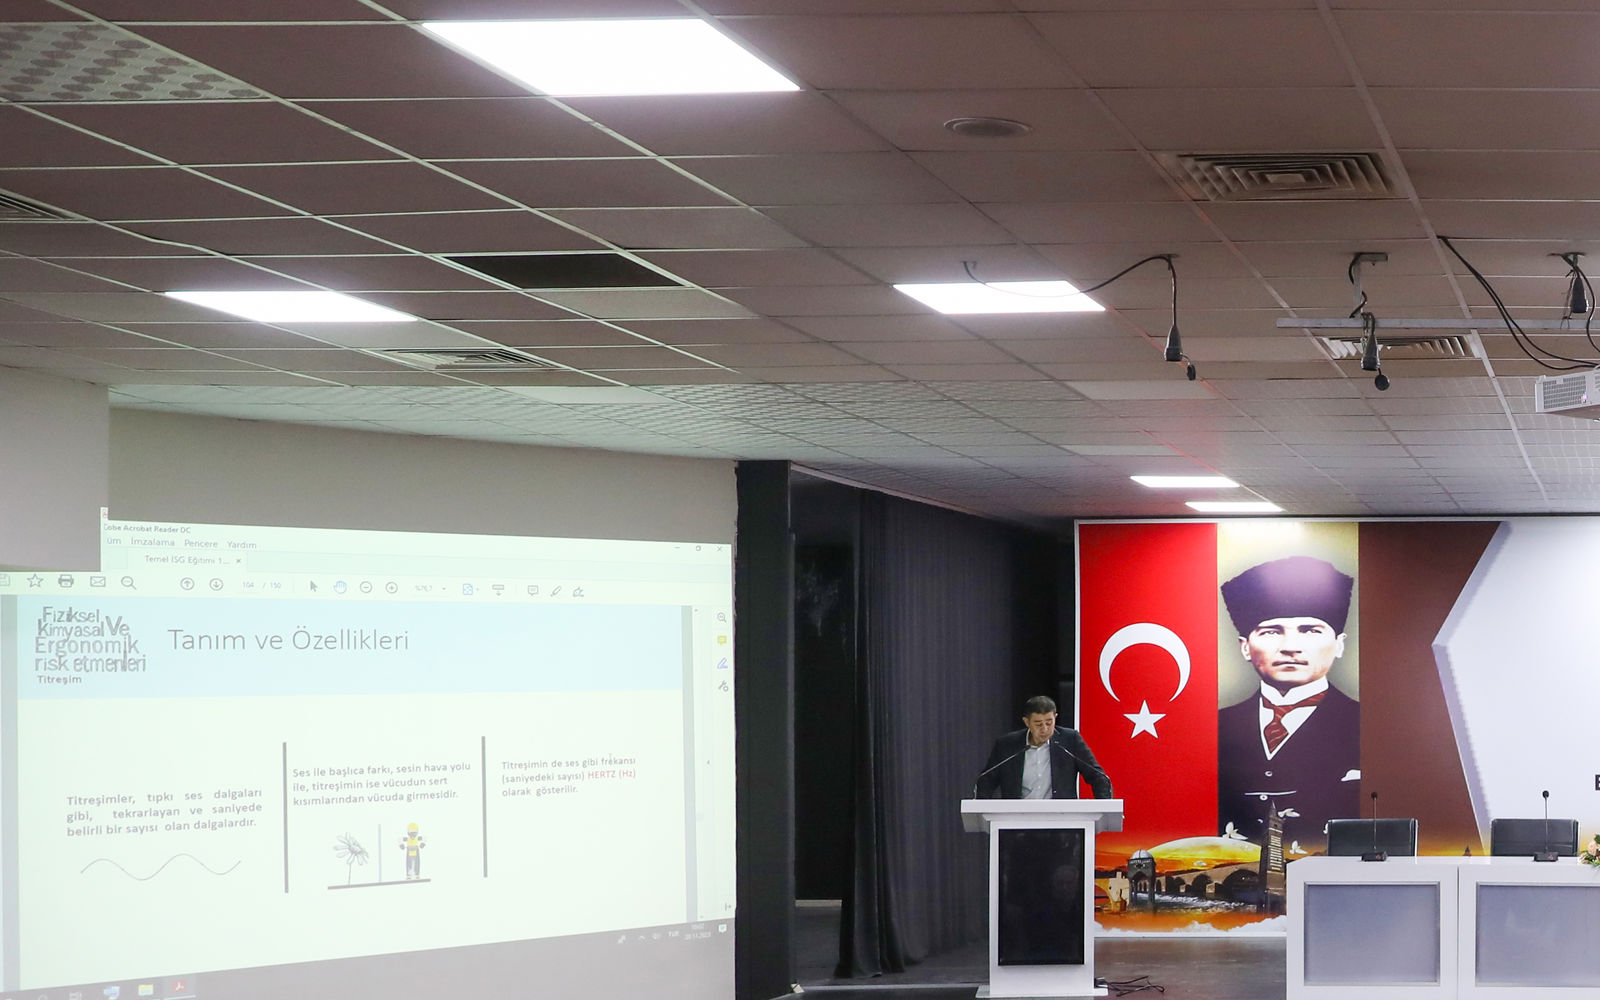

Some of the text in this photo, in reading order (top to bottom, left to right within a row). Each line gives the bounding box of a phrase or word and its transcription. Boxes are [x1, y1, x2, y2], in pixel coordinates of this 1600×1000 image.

[123, 524, 152, 533] Acrobat
[154, 526, 179, 534] Reader
[180, 526, 191, 534] DC
[184, 539, 218, 549] Pencere
[227, 541, 257, 550] Yardım
[145, 555, 169, 564] Temel
[42, 606, 100, 623] Fiziksel
[37, 615, 130, 642] Kimyasal Ve
[35, 634, 140, 658] Ergonomik
[167, 625, 409, 650] Tanım ve Özellikleri
[34, 649, 147, 673] risk etmenleri
[37, 675, 82, 686] Titreşim
[292, 761, 471, 778] Ses ile başlıca farkı, sesin hava yolu
[502, 760, 548, 771] Titreşimin
[551, 759, 562, 768] de
[565, 759, 580, 767] ses
[582, 758, 598, 769] gibi
[312, 780, 363, 792] titreşimin
[366, 779, 380, 789] ise
[382, 777, 426, 788] vücudun
[428, 776, 448, 786] sert
[502, 773, 555, 785] (saniyedeki
[587, 770, 616, 780] HERTZ
[619, 769, 636, 780] (Hz)
[67, 787, 263, 807] Titreşimler, tıpkı ses dalgaları
[293, 789, 459, 807] kısımlarından vücuda girmesidir.
[502, 784, 578, 797] olarak gösterilir.
[66, 802, 263, 824] gibi, tekrarlayan ve saniyede
[67, 817, 257, 837] belirli bir sayısı olan dalgalardır.
